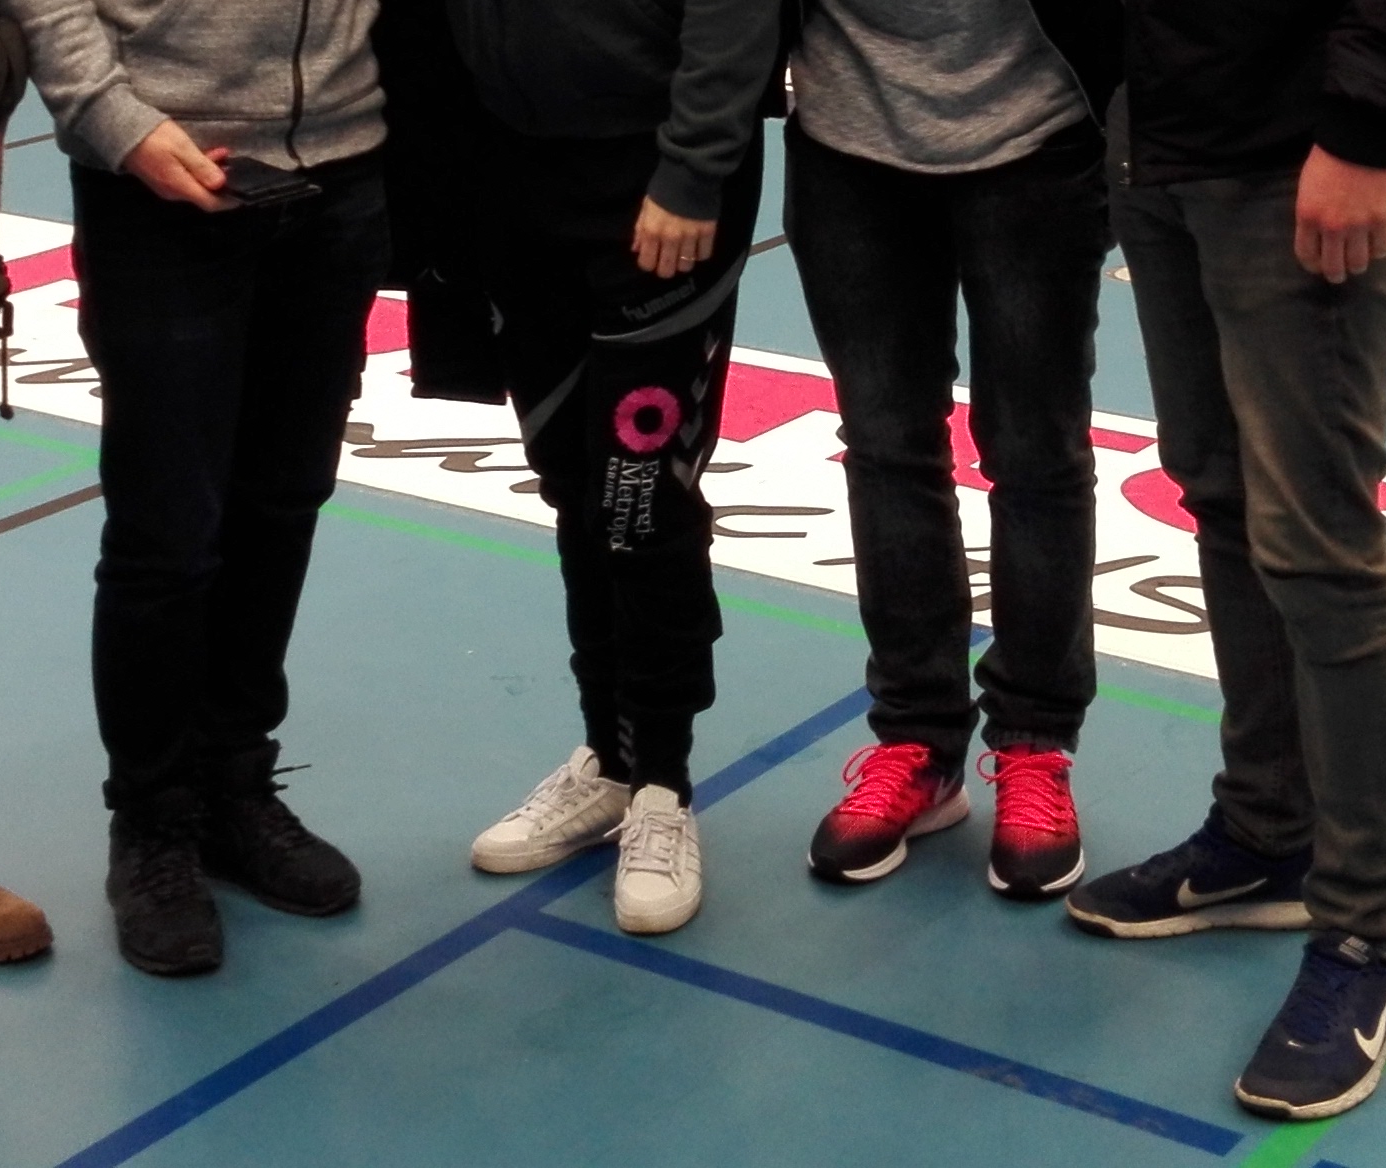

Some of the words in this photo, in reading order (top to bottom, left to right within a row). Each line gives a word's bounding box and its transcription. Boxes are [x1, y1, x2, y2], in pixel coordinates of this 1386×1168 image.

[622, 277, 697, 322] hummel
[601, 456, 620, 509] ESBJERG
[608, 459, 644, 552] Metropol
